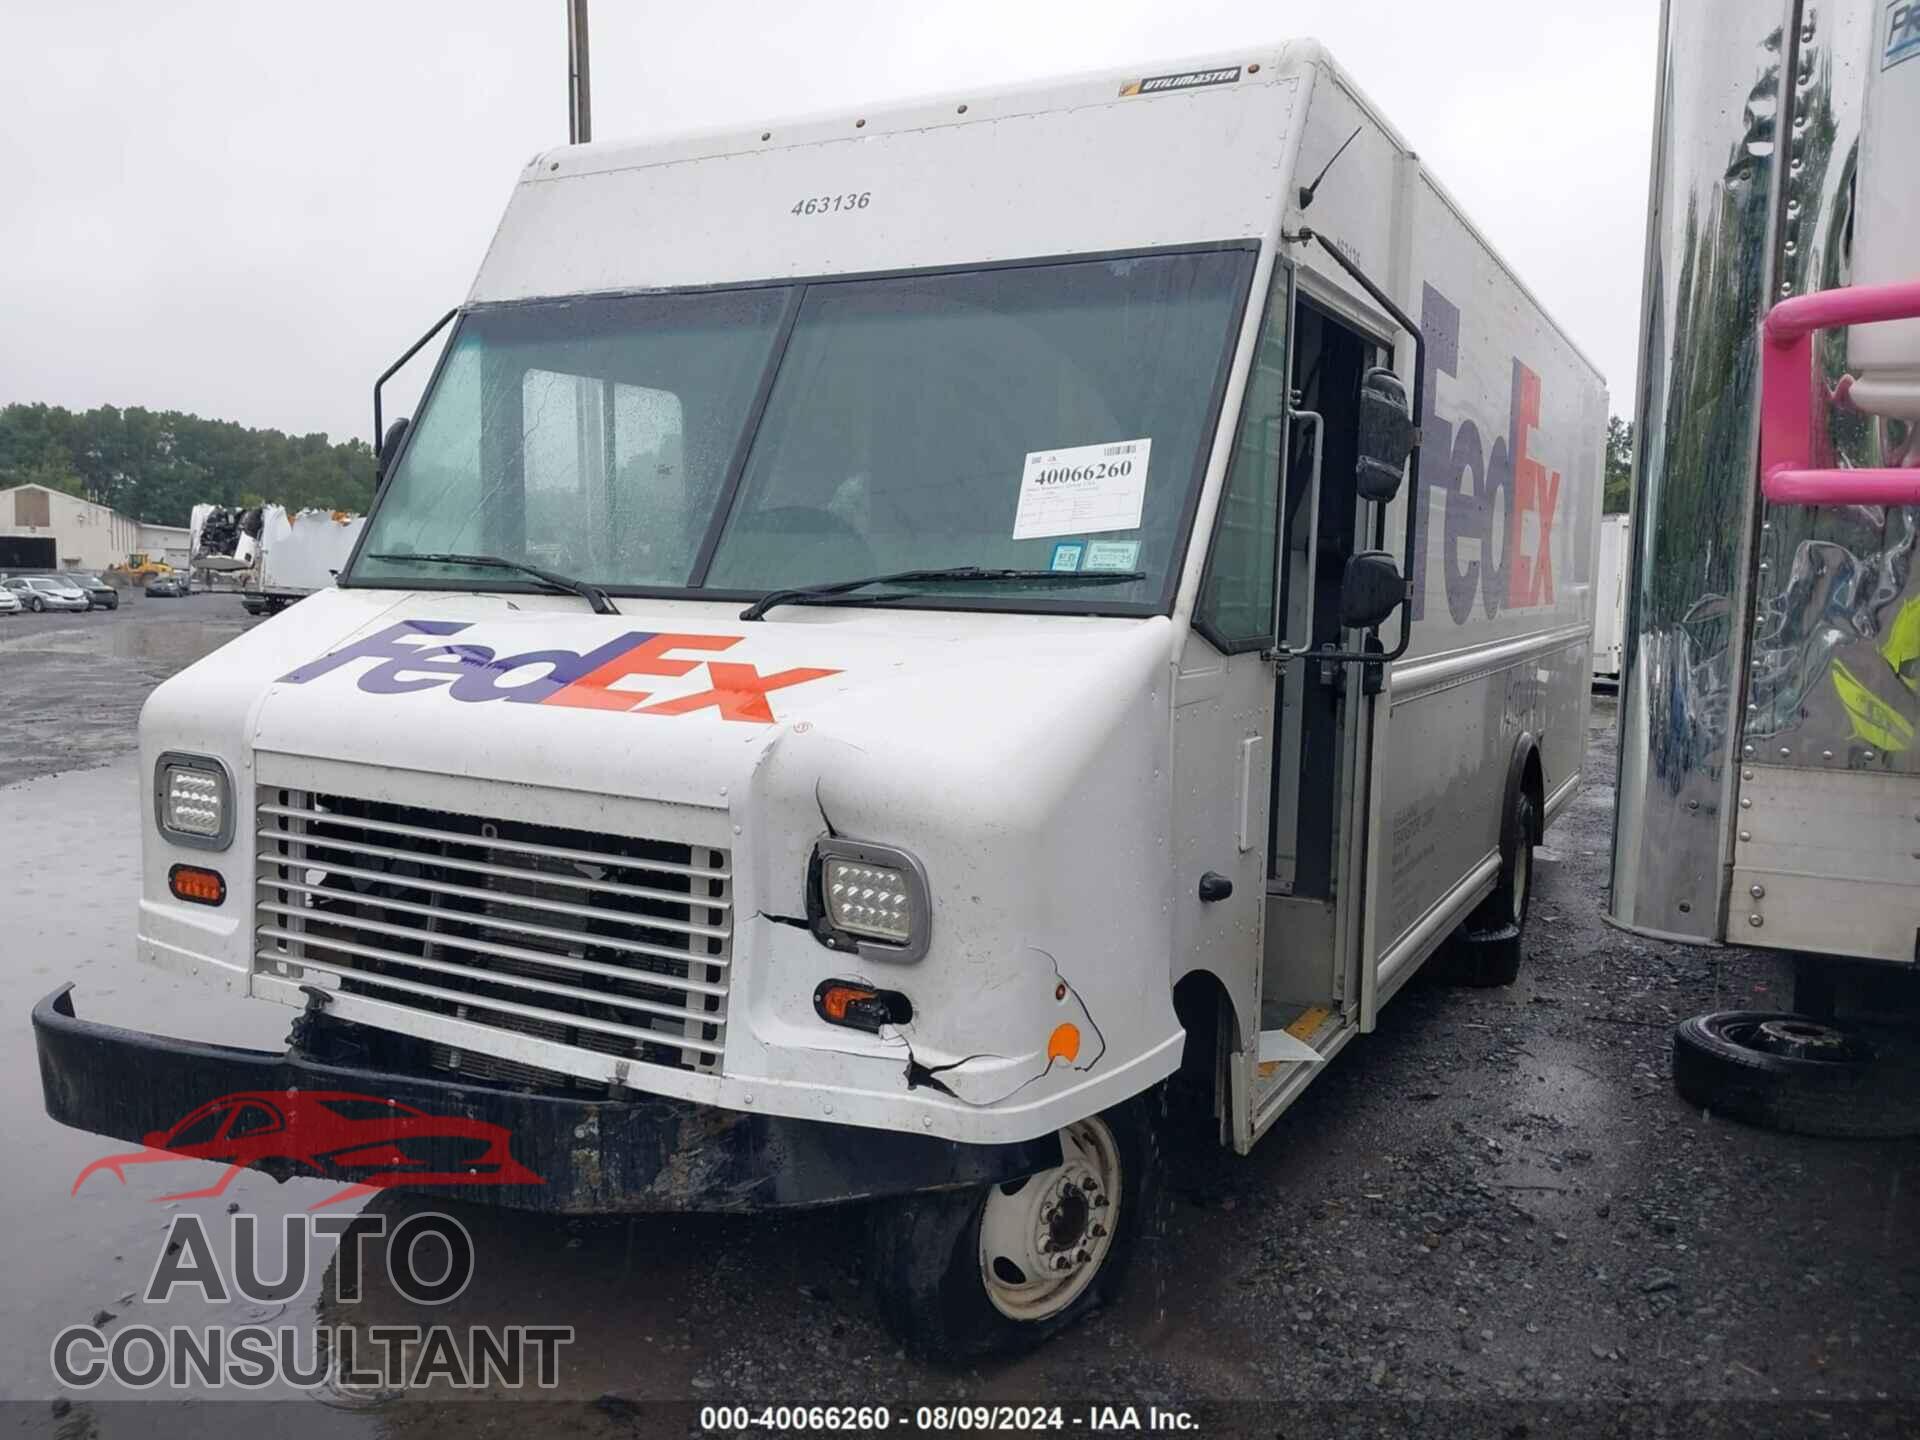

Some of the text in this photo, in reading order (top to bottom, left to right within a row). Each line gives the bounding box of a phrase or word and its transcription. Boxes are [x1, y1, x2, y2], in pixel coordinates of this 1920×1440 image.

[1143, 69, 1239, 90] UTILIMASTER
[791, 191, 871, 217] 463136
[1411, 280, 1560, 626] FedEx
[1035, 460, 1132, 485] 40066260
[273, 620, 847, 723] FedEx
